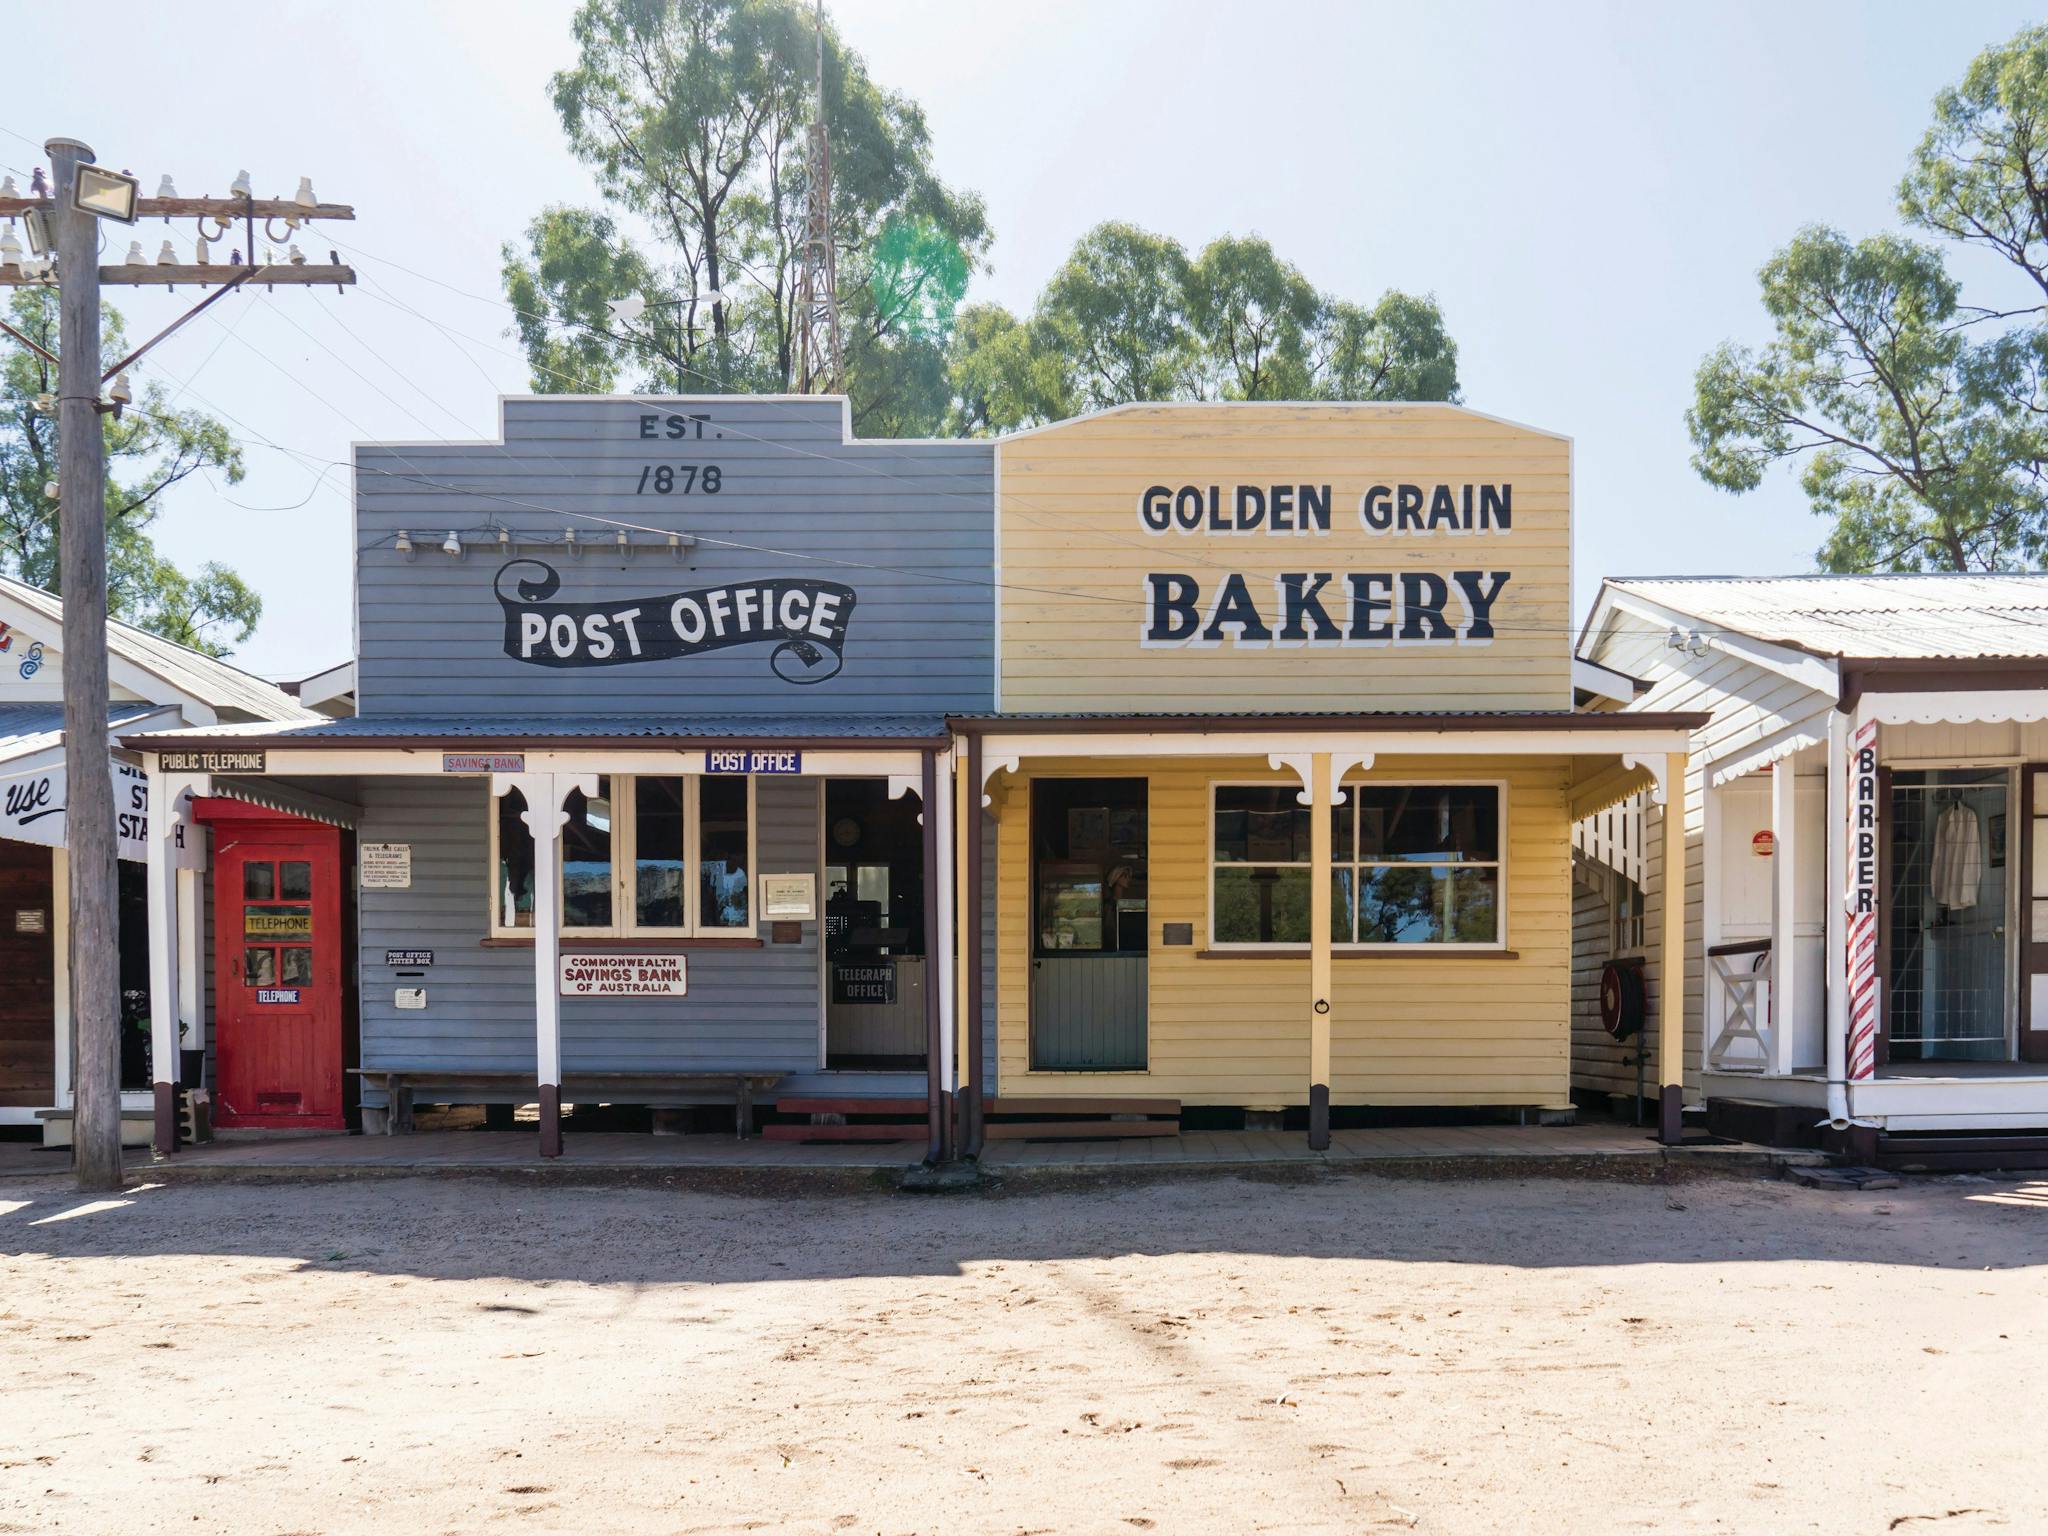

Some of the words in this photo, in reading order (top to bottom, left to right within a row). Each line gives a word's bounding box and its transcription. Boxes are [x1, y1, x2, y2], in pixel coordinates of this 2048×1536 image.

[640, 414, 723, 440] EST.
[636, 465, 722, 495] 1878
[1138, 484, 1332, 535] GOLDEN
[1360, 484, 1512, 535] GRAIN
[1140, 571, 1512, 648] BAKERY
[521, 607, 642, 659] POST
[670, 588, 842, 644] OFFICE
[161, 753, 199, 769] PUBLIC
[201, 753, 263, 769] TELEPHONE
[494, 758, 521, 769] BANK
[711, 753, 747, 771] POST
[751, 753, 796, 771] OFFICE
[1857, 748, 1875, 913] BARBER
[250, 917, 310, 930] TELEPHONE
[571, 958, 677, 967] COMMONWEALTH
[565, 968, 632, 982] SAVINGS
[638, 968, 682, 982] BANK
[838, 968, 893, 981] TELEGRAPH
[576, 983, 593, 992] OF
[599, 983, 671, 992] AUSTRALIA
[847, 984, 884, 997] OFFICE
[258, 990, 298, 1003] TELEPHONE
